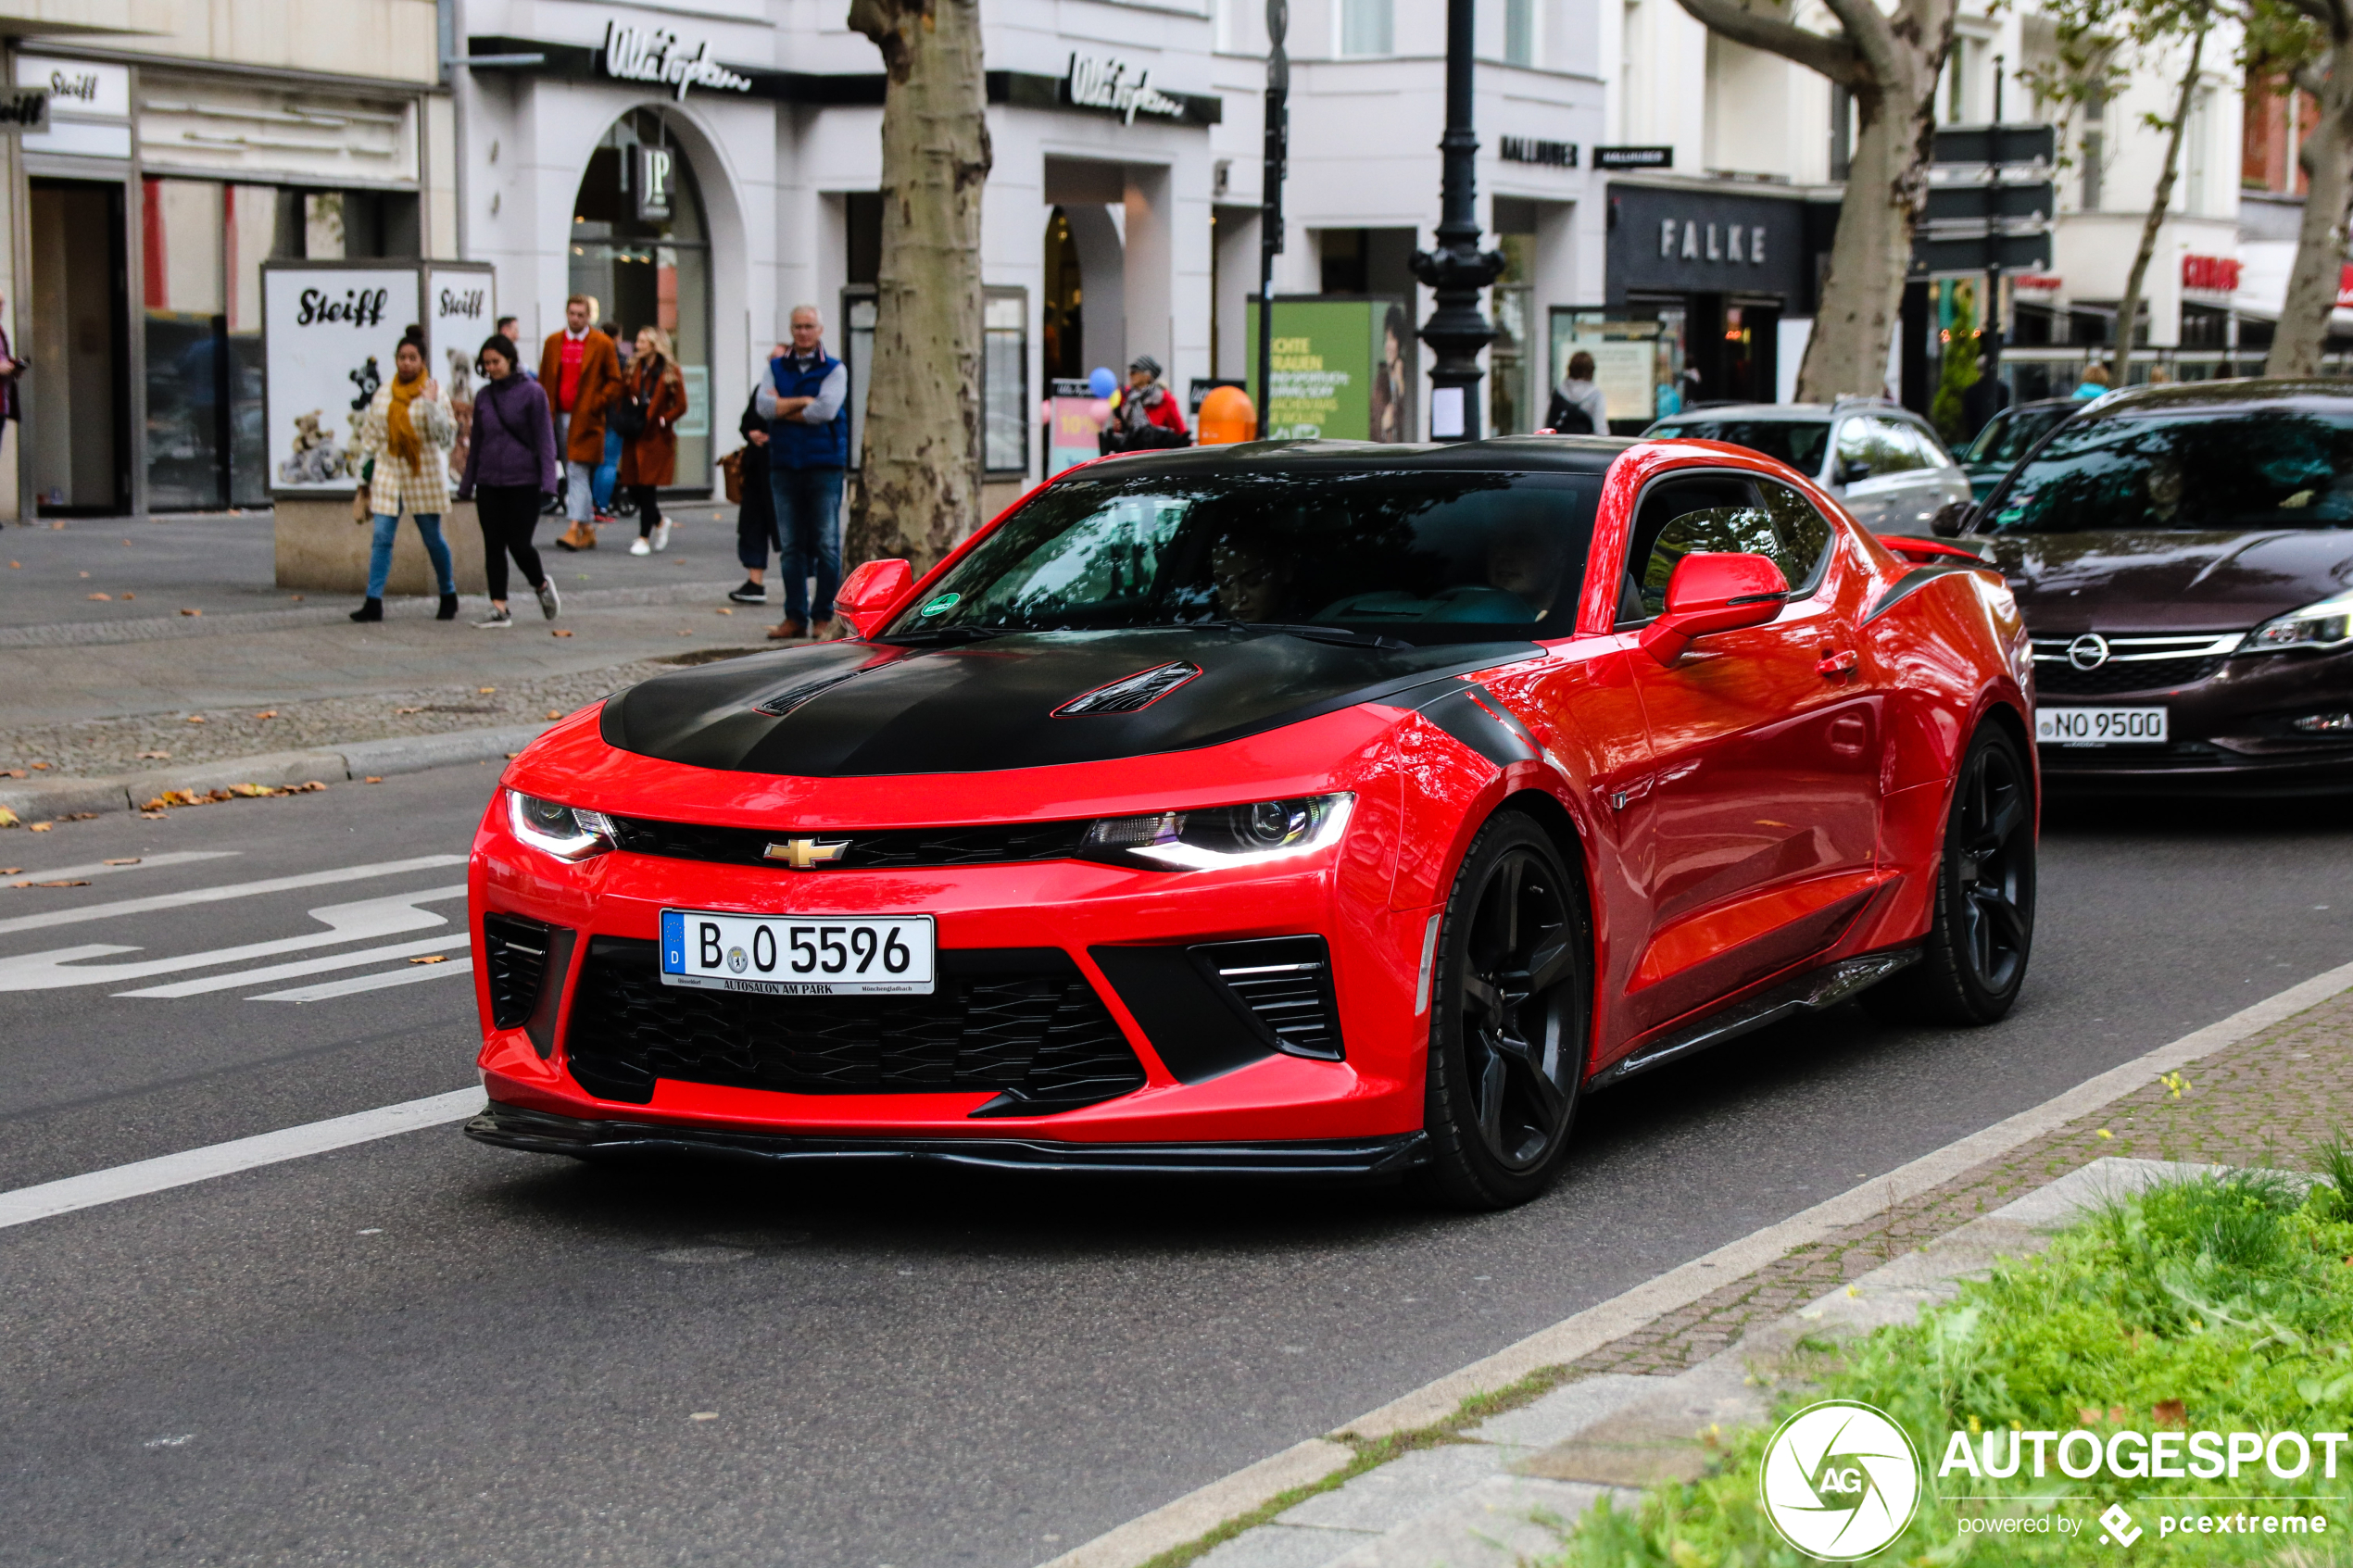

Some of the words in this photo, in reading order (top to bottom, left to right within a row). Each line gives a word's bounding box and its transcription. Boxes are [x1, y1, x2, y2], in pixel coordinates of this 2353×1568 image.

[50, 70, 97, 101] Steiff
[1661, 219, 1766, 263] FALKE
[297, 288, 387, 328] Steiff
[440, 289, 484, 319] Steiff
[1270, 355, 1323, 370] RAUEN
[2056, 713, 2088, 737] NO
[2095, 713, 2161, 737] 9500
[671, 950, 679, 964] D
[700, 922, 724, 969] B
[789, 926, 911, 973] 5596
[724, 980, 779, 994] AUTOSALON
[782, 984, 799, 995] AM
[802, 984, 833, 995] PARK
